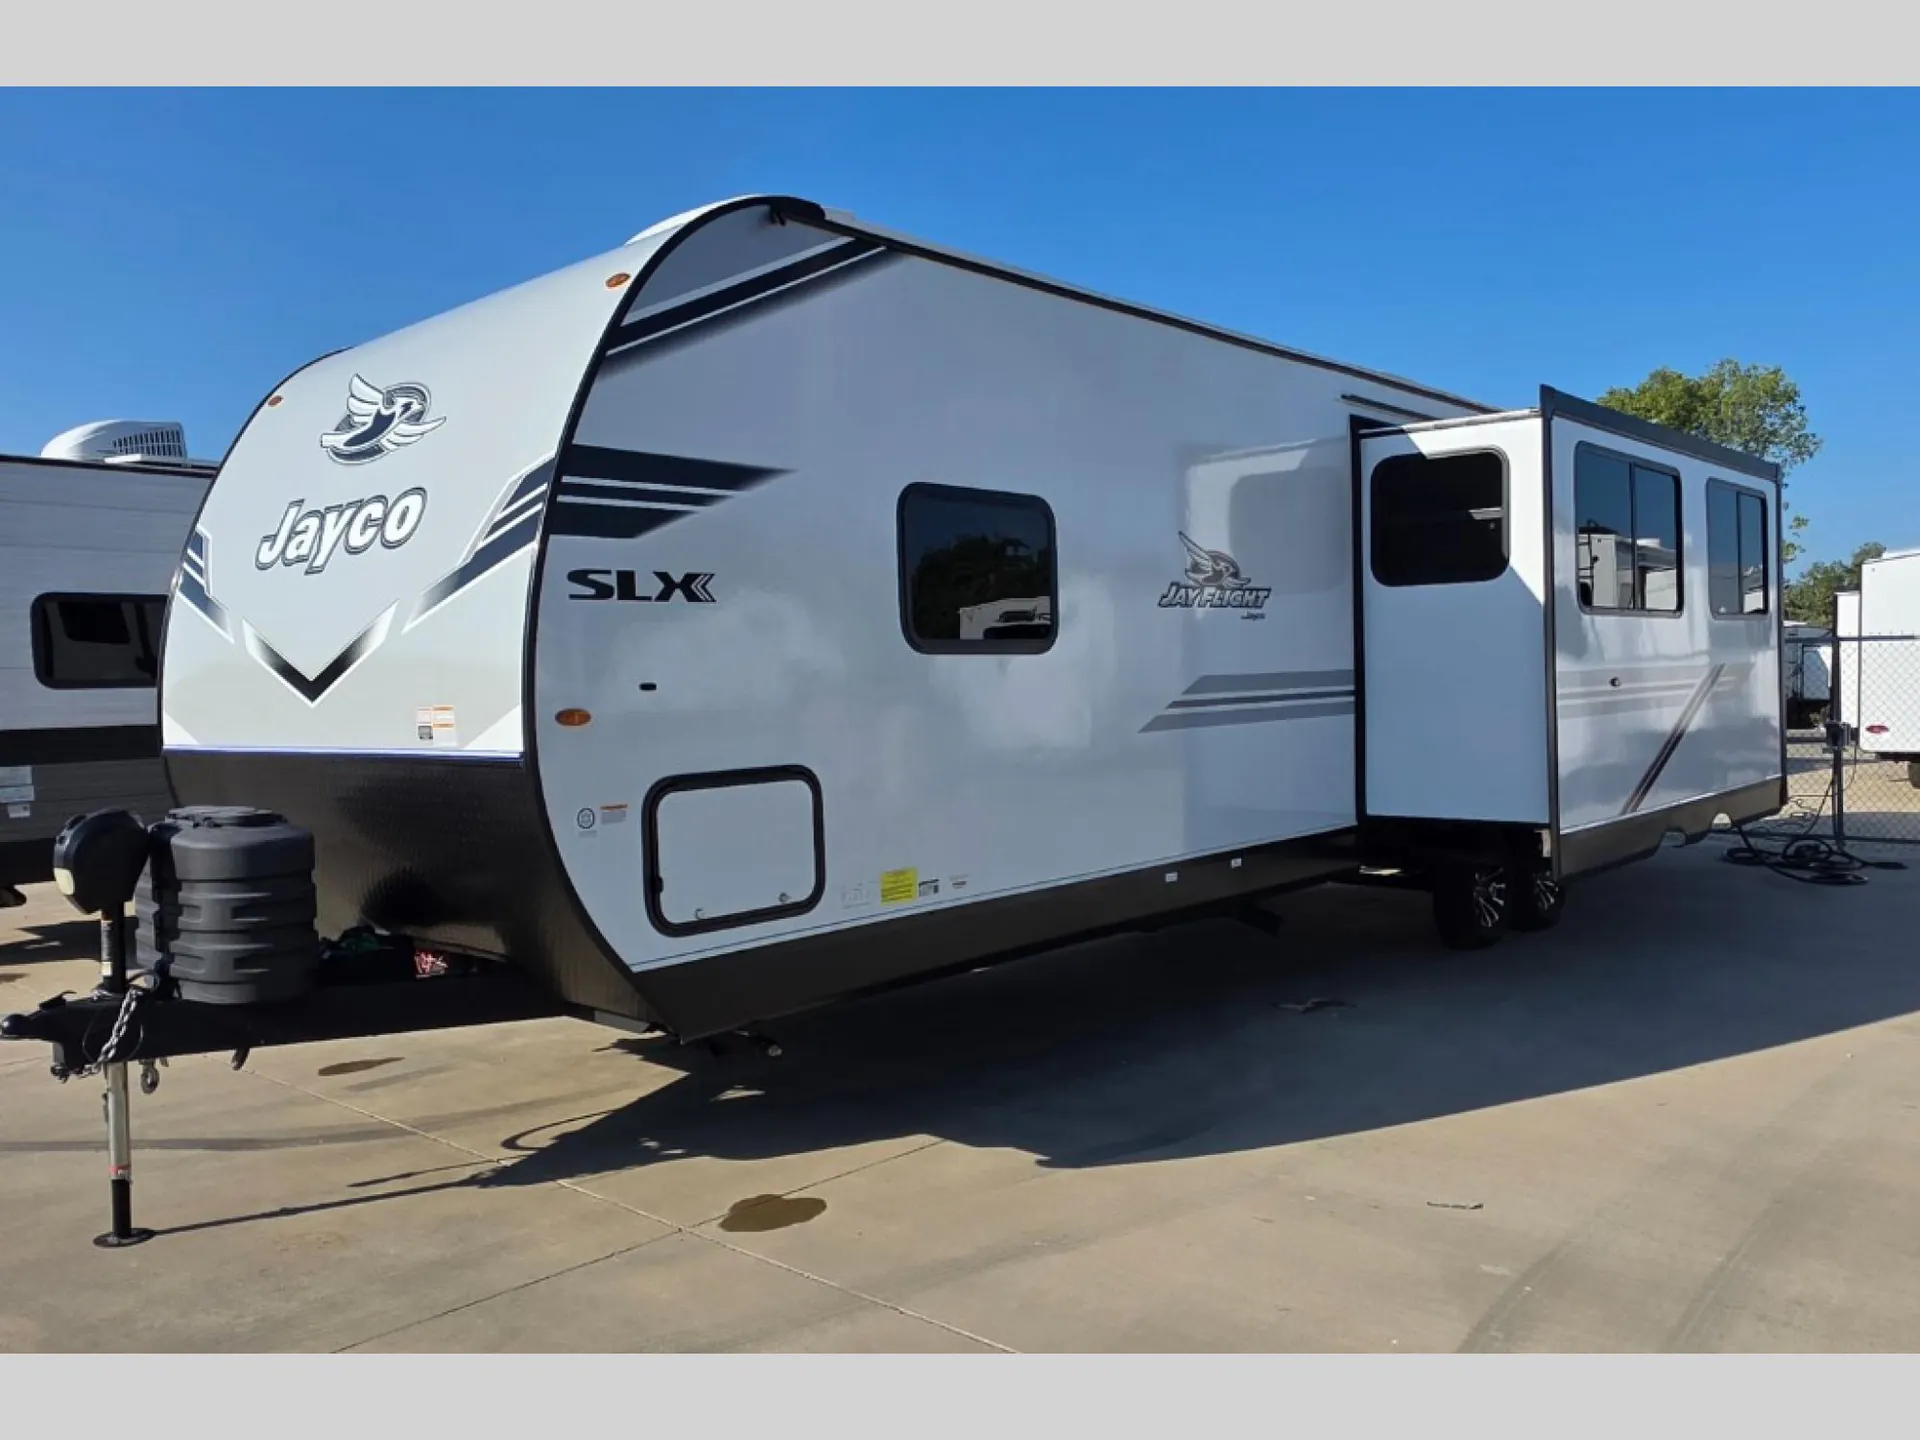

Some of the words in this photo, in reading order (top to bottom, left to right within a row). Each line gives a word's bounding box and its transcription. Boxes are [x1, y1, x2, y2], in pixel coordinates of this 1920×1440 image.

[255, 486, 428, 576] Jayco
[566, 568, 717, 603] SLX
[1158, 581, 1201, 608] JAY
[1198, 585, 1272, 609] FLIGHT
